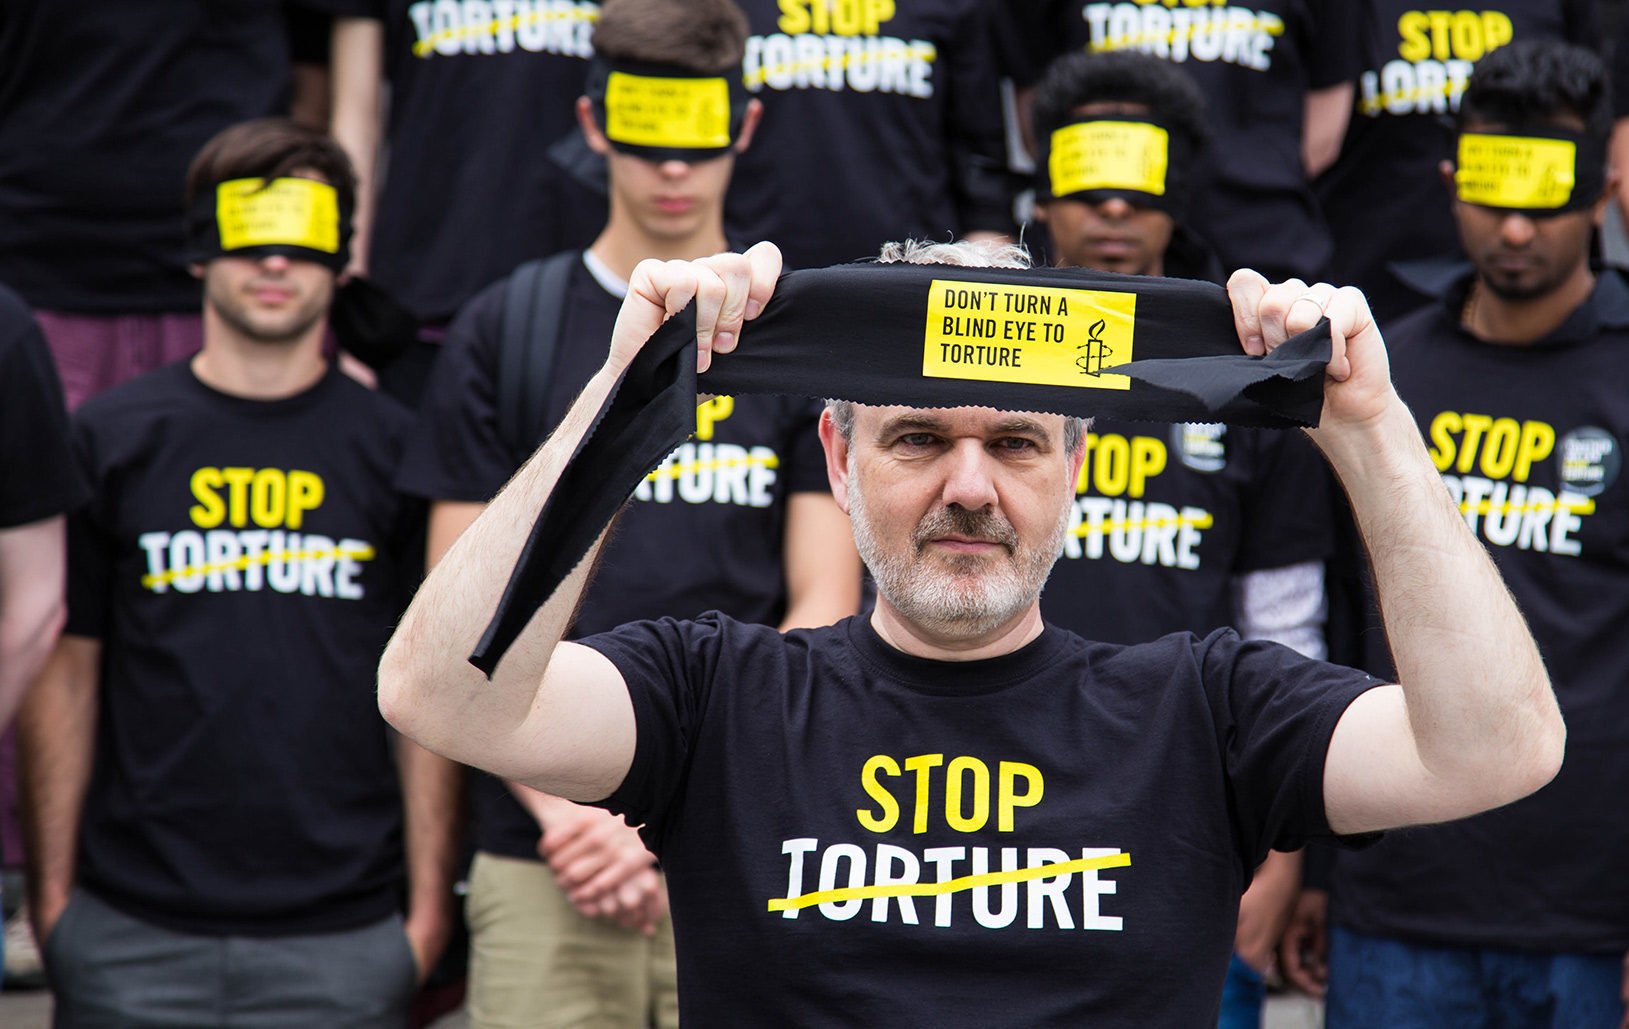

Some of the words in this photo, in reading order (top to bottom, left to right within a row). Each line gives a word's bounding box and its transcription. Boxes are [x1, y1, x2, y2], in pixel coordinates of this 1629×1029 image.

[777, 0, 896, 36] STOP
[1083, 2, 1281, 71] TORTURE
[1398, 10, 1513, 62] STOP
[1361, 60, 1474, 117] TORT
[942, 316, 997, 339] BLIND
[1003, 320, 1037, 341] EYE
[1043, 323, 1065, 343] TO
[944, 289, 998, 311] DON'T
[1004, 293, 1051, 315] TURN
[1057, 297, 1068, 316] A
[940, 343, 1022, 368] TORTURE
[1076, 433, 1167, 498] TOP
[1428, 411, 1555, 482] STOP
[189, 466, 325, 529] STOP
[138, 530, 370, 600] TORTURE
[856, 753, 1044, 834] STOP
[781, 838, 1124, 931] TORTURE
